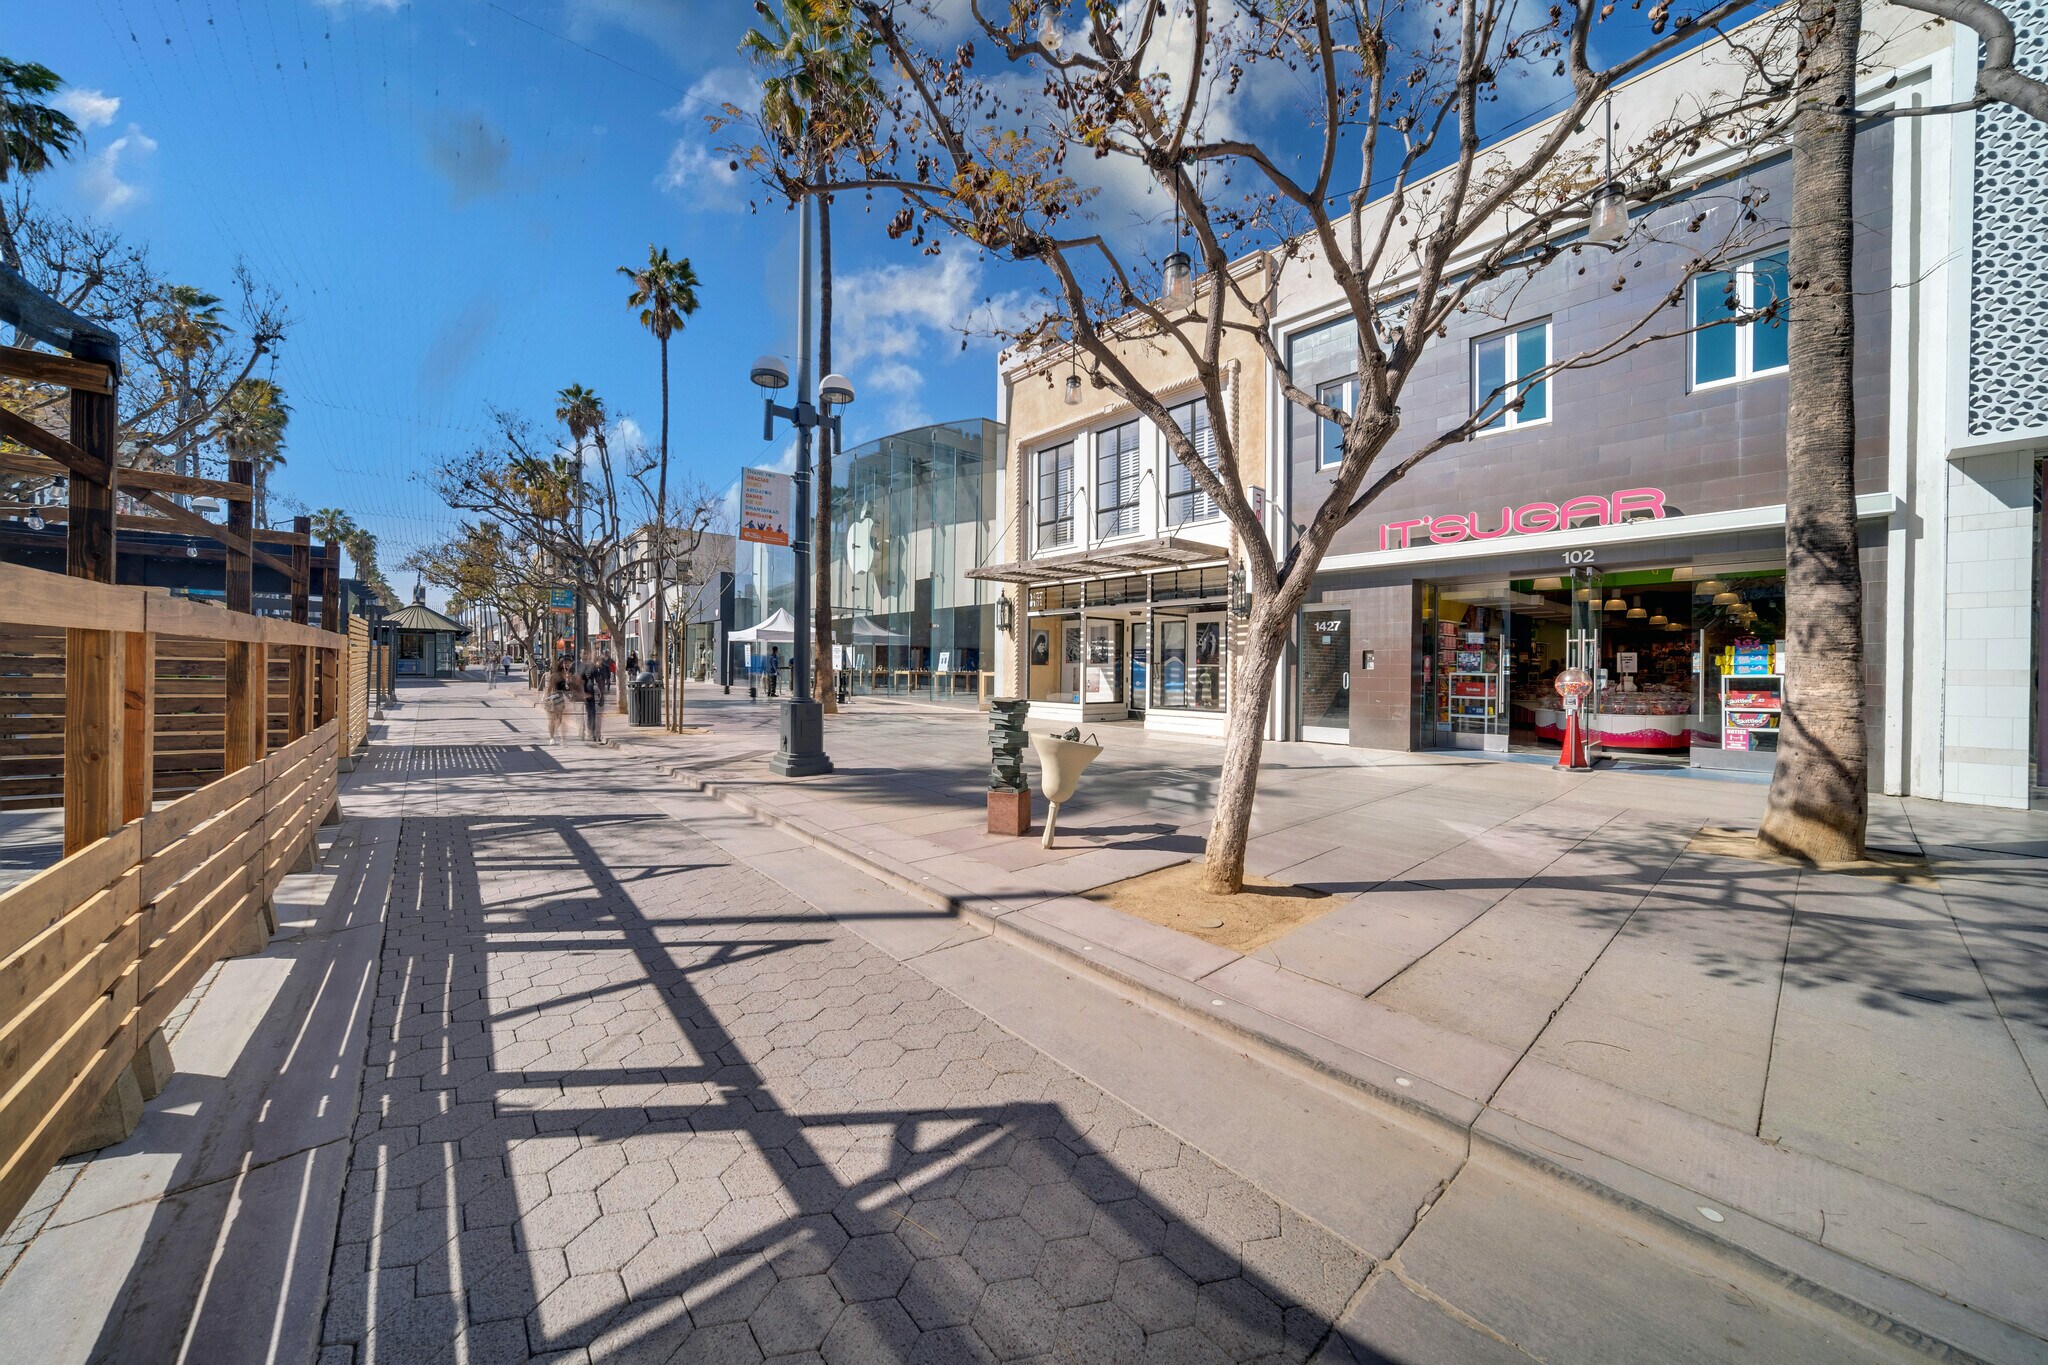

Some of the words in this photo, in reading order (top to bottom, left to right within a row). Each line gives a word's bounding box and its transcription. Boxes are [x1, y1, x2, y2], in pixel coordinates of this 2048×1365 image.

[747, 475, 768, 483] GRACIAS
[1379, 487, 1666, 551] IT'SUGAR
[1562, 549, 1595, 564] 102
[1314, 620, 1341, 631] 1427
